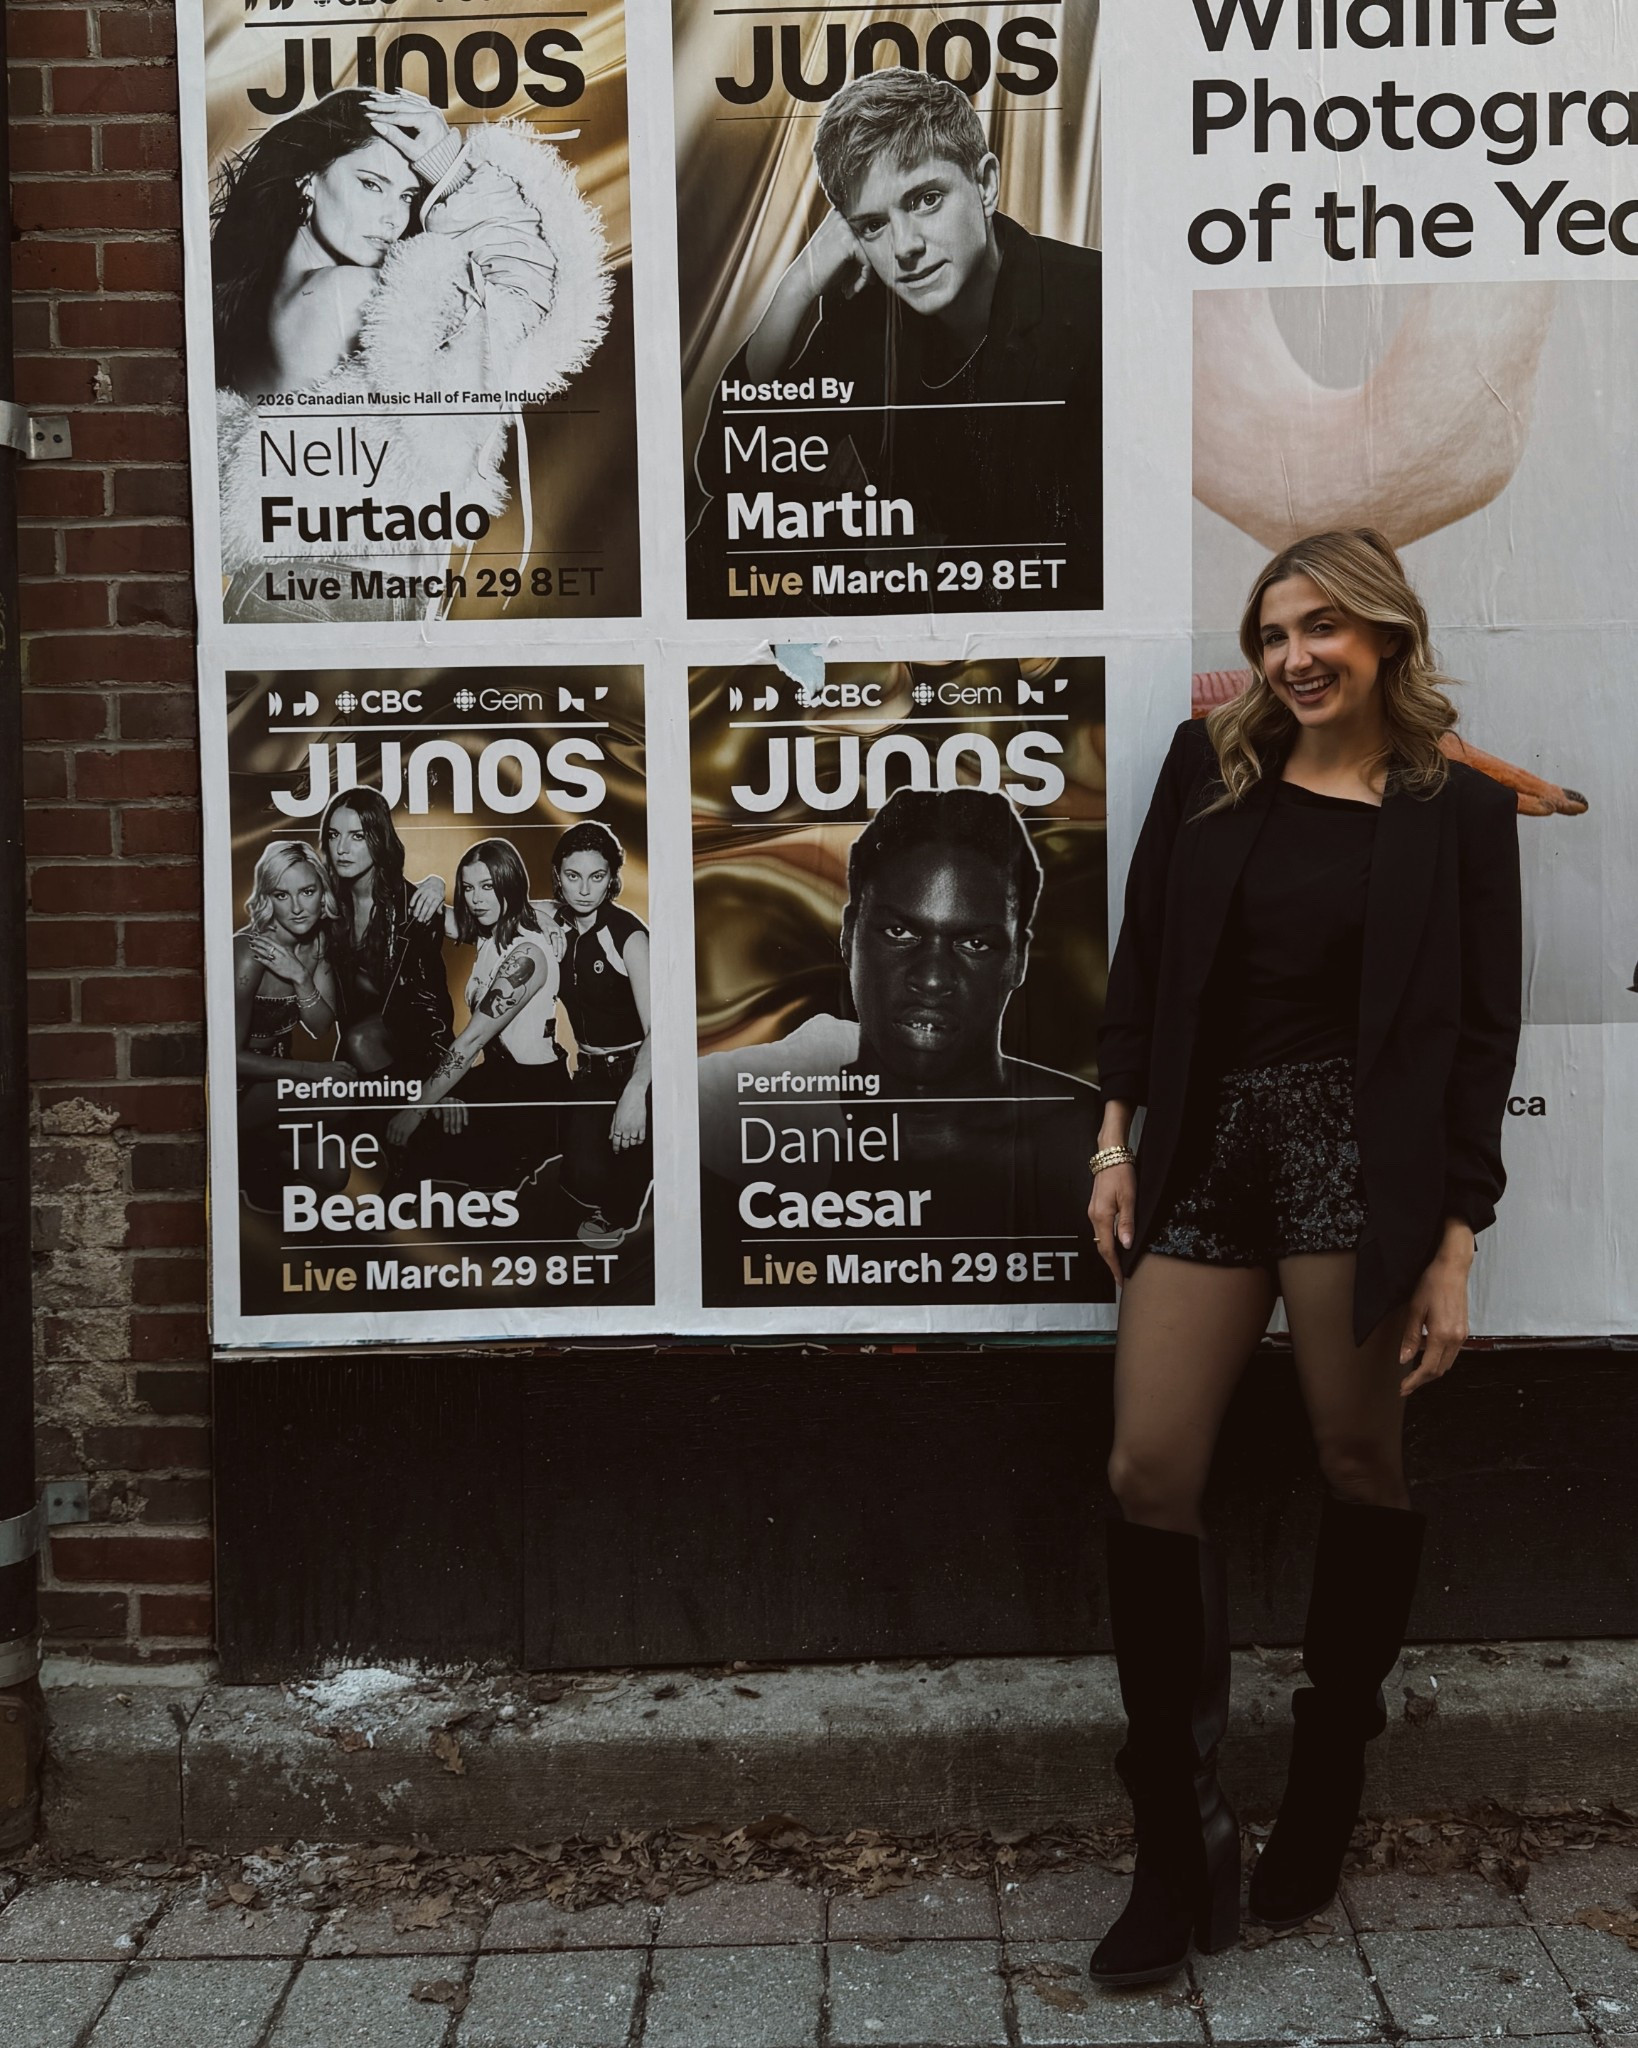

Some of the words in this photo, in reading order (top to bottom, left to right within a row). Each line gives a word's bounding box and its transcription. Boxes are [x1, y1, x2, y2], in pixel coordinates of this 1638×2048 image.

[1191, 0, 1557, 52] Wildlife
[1192, 78, 1638, 166] Photogra
[1187, 183, 1291, 265] of
[1315, 185, 1474, 262] the
[256, 393, 295, 406] 2026
[297, 392, 365, 405] Canadian
[367, 391, 411, 405] Music
[414, 391, 442, 404] Hall
[444, 391, 460, 404] of
[462, 391, 502, 403] Fame
[720, 378, 815, 402] Hosted
[821, 377, 855, 404] By
[259, 426, 389, 488] Nelly
[724, 425, 829, 474] Mae
[261, 491, 491, 543] Furtado
[727, 484, 914, 540] Martin
[265, 571, 341, 601] Live
[350, 569, 467, 600] March
[476, 568, 522, 598] 29
[728, 565, 803, 597] Live
[812, 562, 928, 595] March
[936, 560, 983, 591] 29
[361, 690, 423, 713] CBC
[479, 688, 543, 712] Gem
[822, 683, 882, 707] CBC
[937, 682, 1002, 705] Gem
[277, 1075, 422, 1101] Performing
[737, 1069, 880, 1096] Performing
[1506, 1096, 1546, 1116] ca
[278, 1121, 379, 1170] The
[740, 1113, 900, 1164] Daniel
[283, 1179, 520, 1232] Beaches
[738, 1181, 932, 1229] Caesar
[282, 1261, 357, 1292] Live
[366, 1257, 482, 1291] March
[491, 1256, 537, 1286] 29
[743, 1254, 817, 1285] Live
[826, 1252, 942, 1284] March
[951, 1252, 998, 1282] 29
